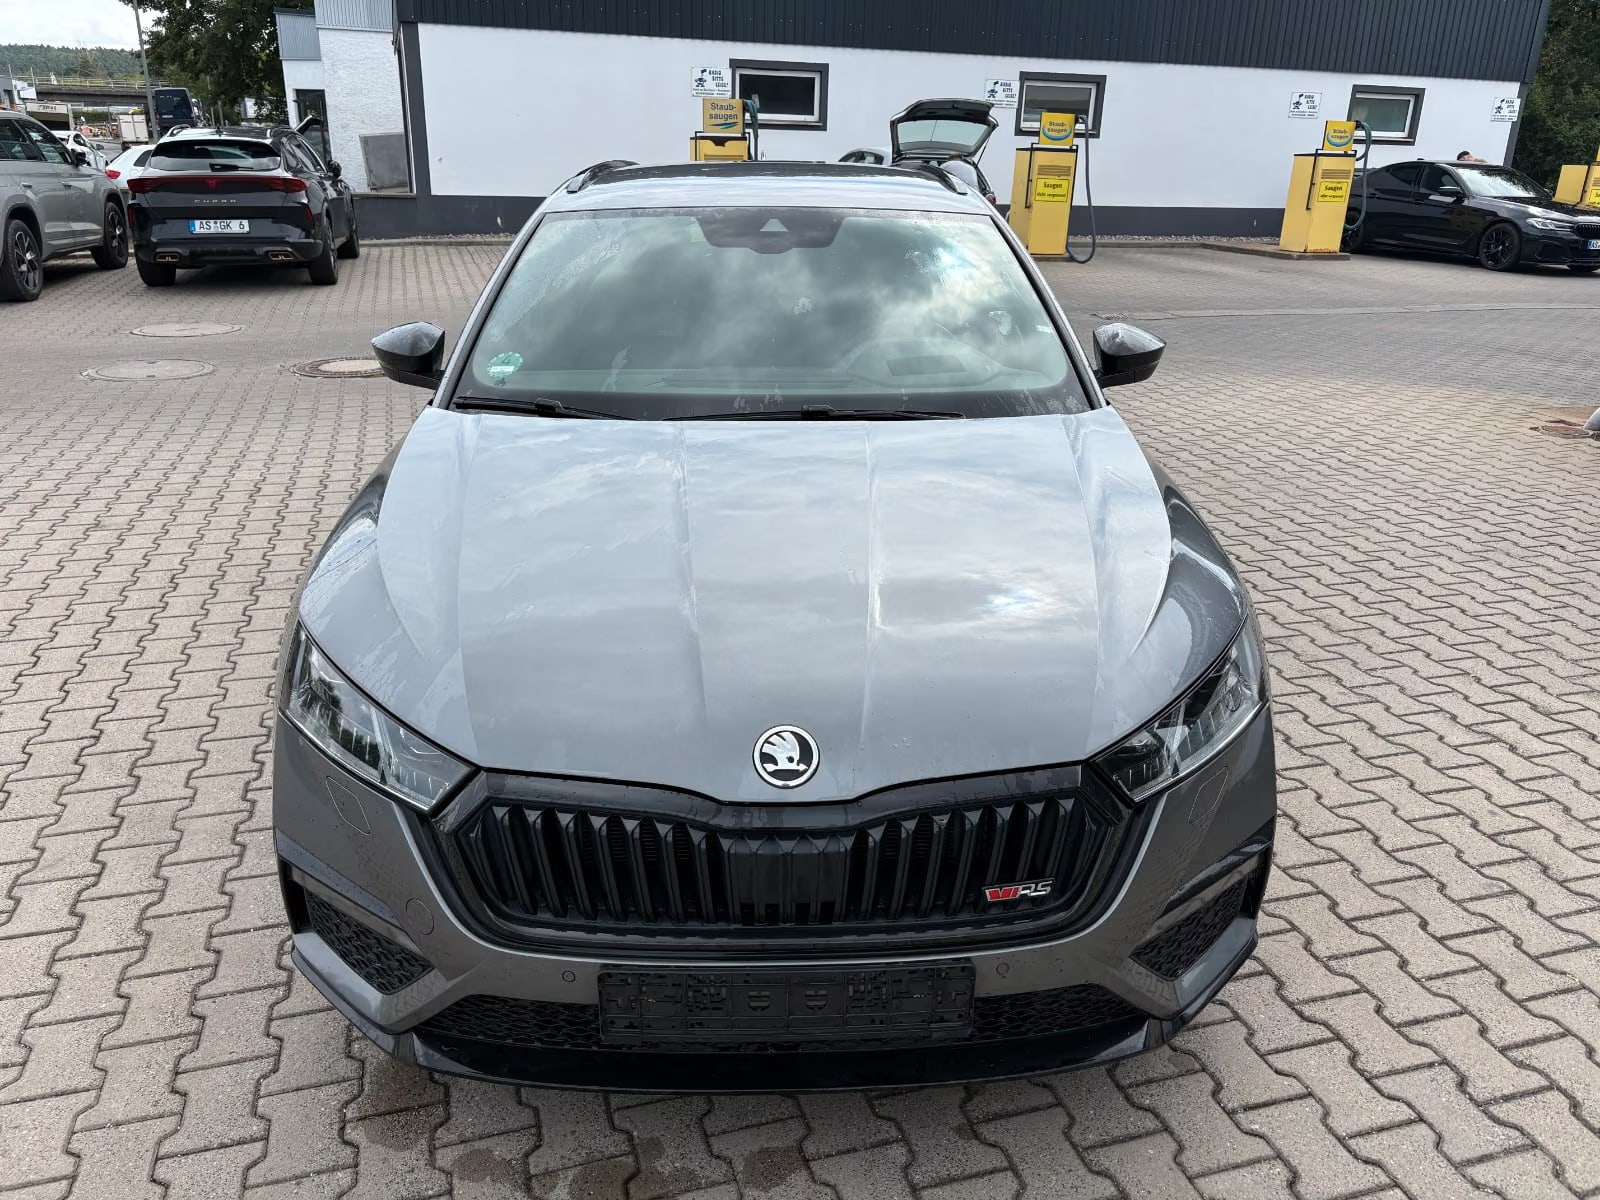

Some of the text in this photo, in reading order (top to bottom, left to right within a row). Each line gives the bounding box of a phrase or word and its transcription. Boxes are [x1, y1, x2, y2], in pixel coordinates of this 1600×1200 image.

[710, 102, 737, 111] Staub-
[709, 113, 738, 121] saugen
[1043, 182, 1063, 190] Saugen
[199, 220, 245, 231] AS GK 6
